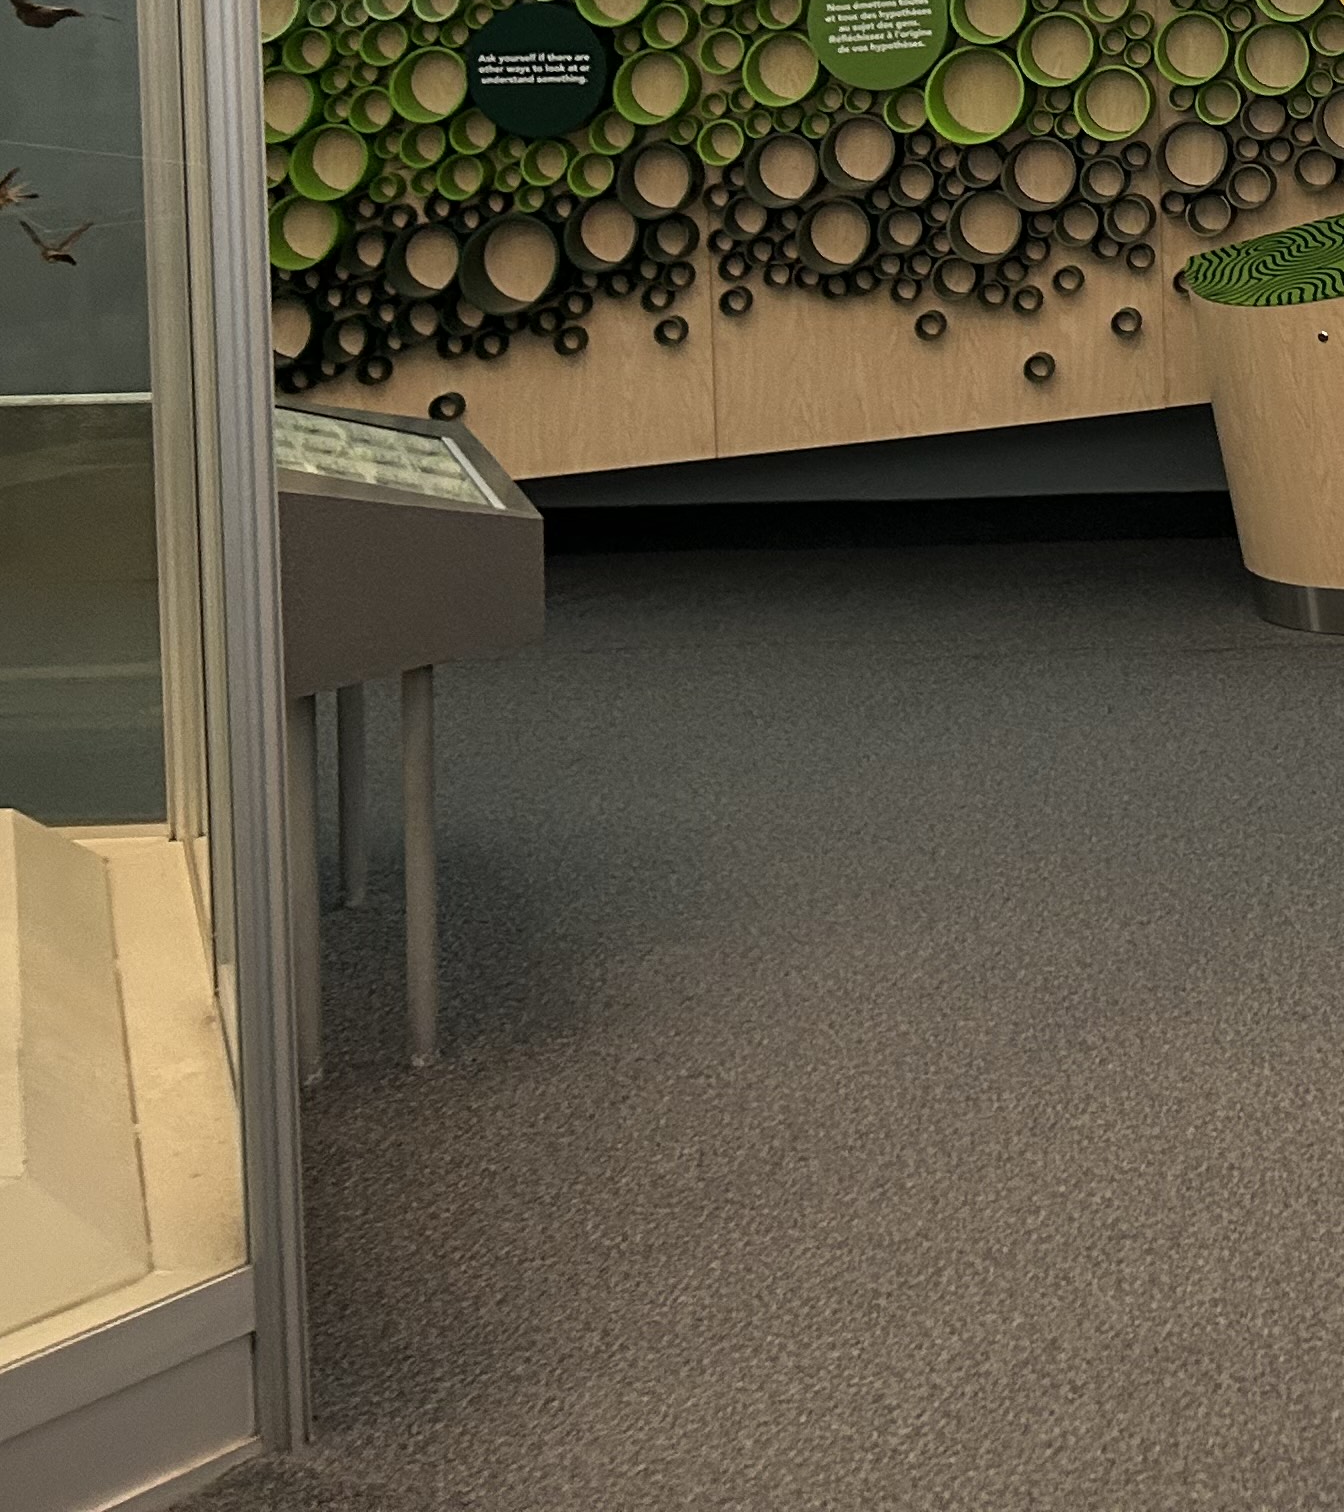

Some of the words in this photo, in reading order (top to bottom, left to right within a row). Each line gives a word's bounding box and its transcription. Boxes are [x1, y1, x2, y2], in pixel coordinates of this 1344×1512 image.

[478, 53, 496, 63] Ask
[498, 53, 537, 65] yourself
[538, 53, 545, 62] if
[546, 53, 572, 62] there
[574, 54, 590, 62] are
[478, 64, 504, 74] other
[506, 66, 531, 75] ways
[532, 64, 543, 73] to
[545, 63, 565, 72] look
[567, 64, 578, 72] at
[481, 74, 535, 84] understand
[536, 74, 589, 85] something.
